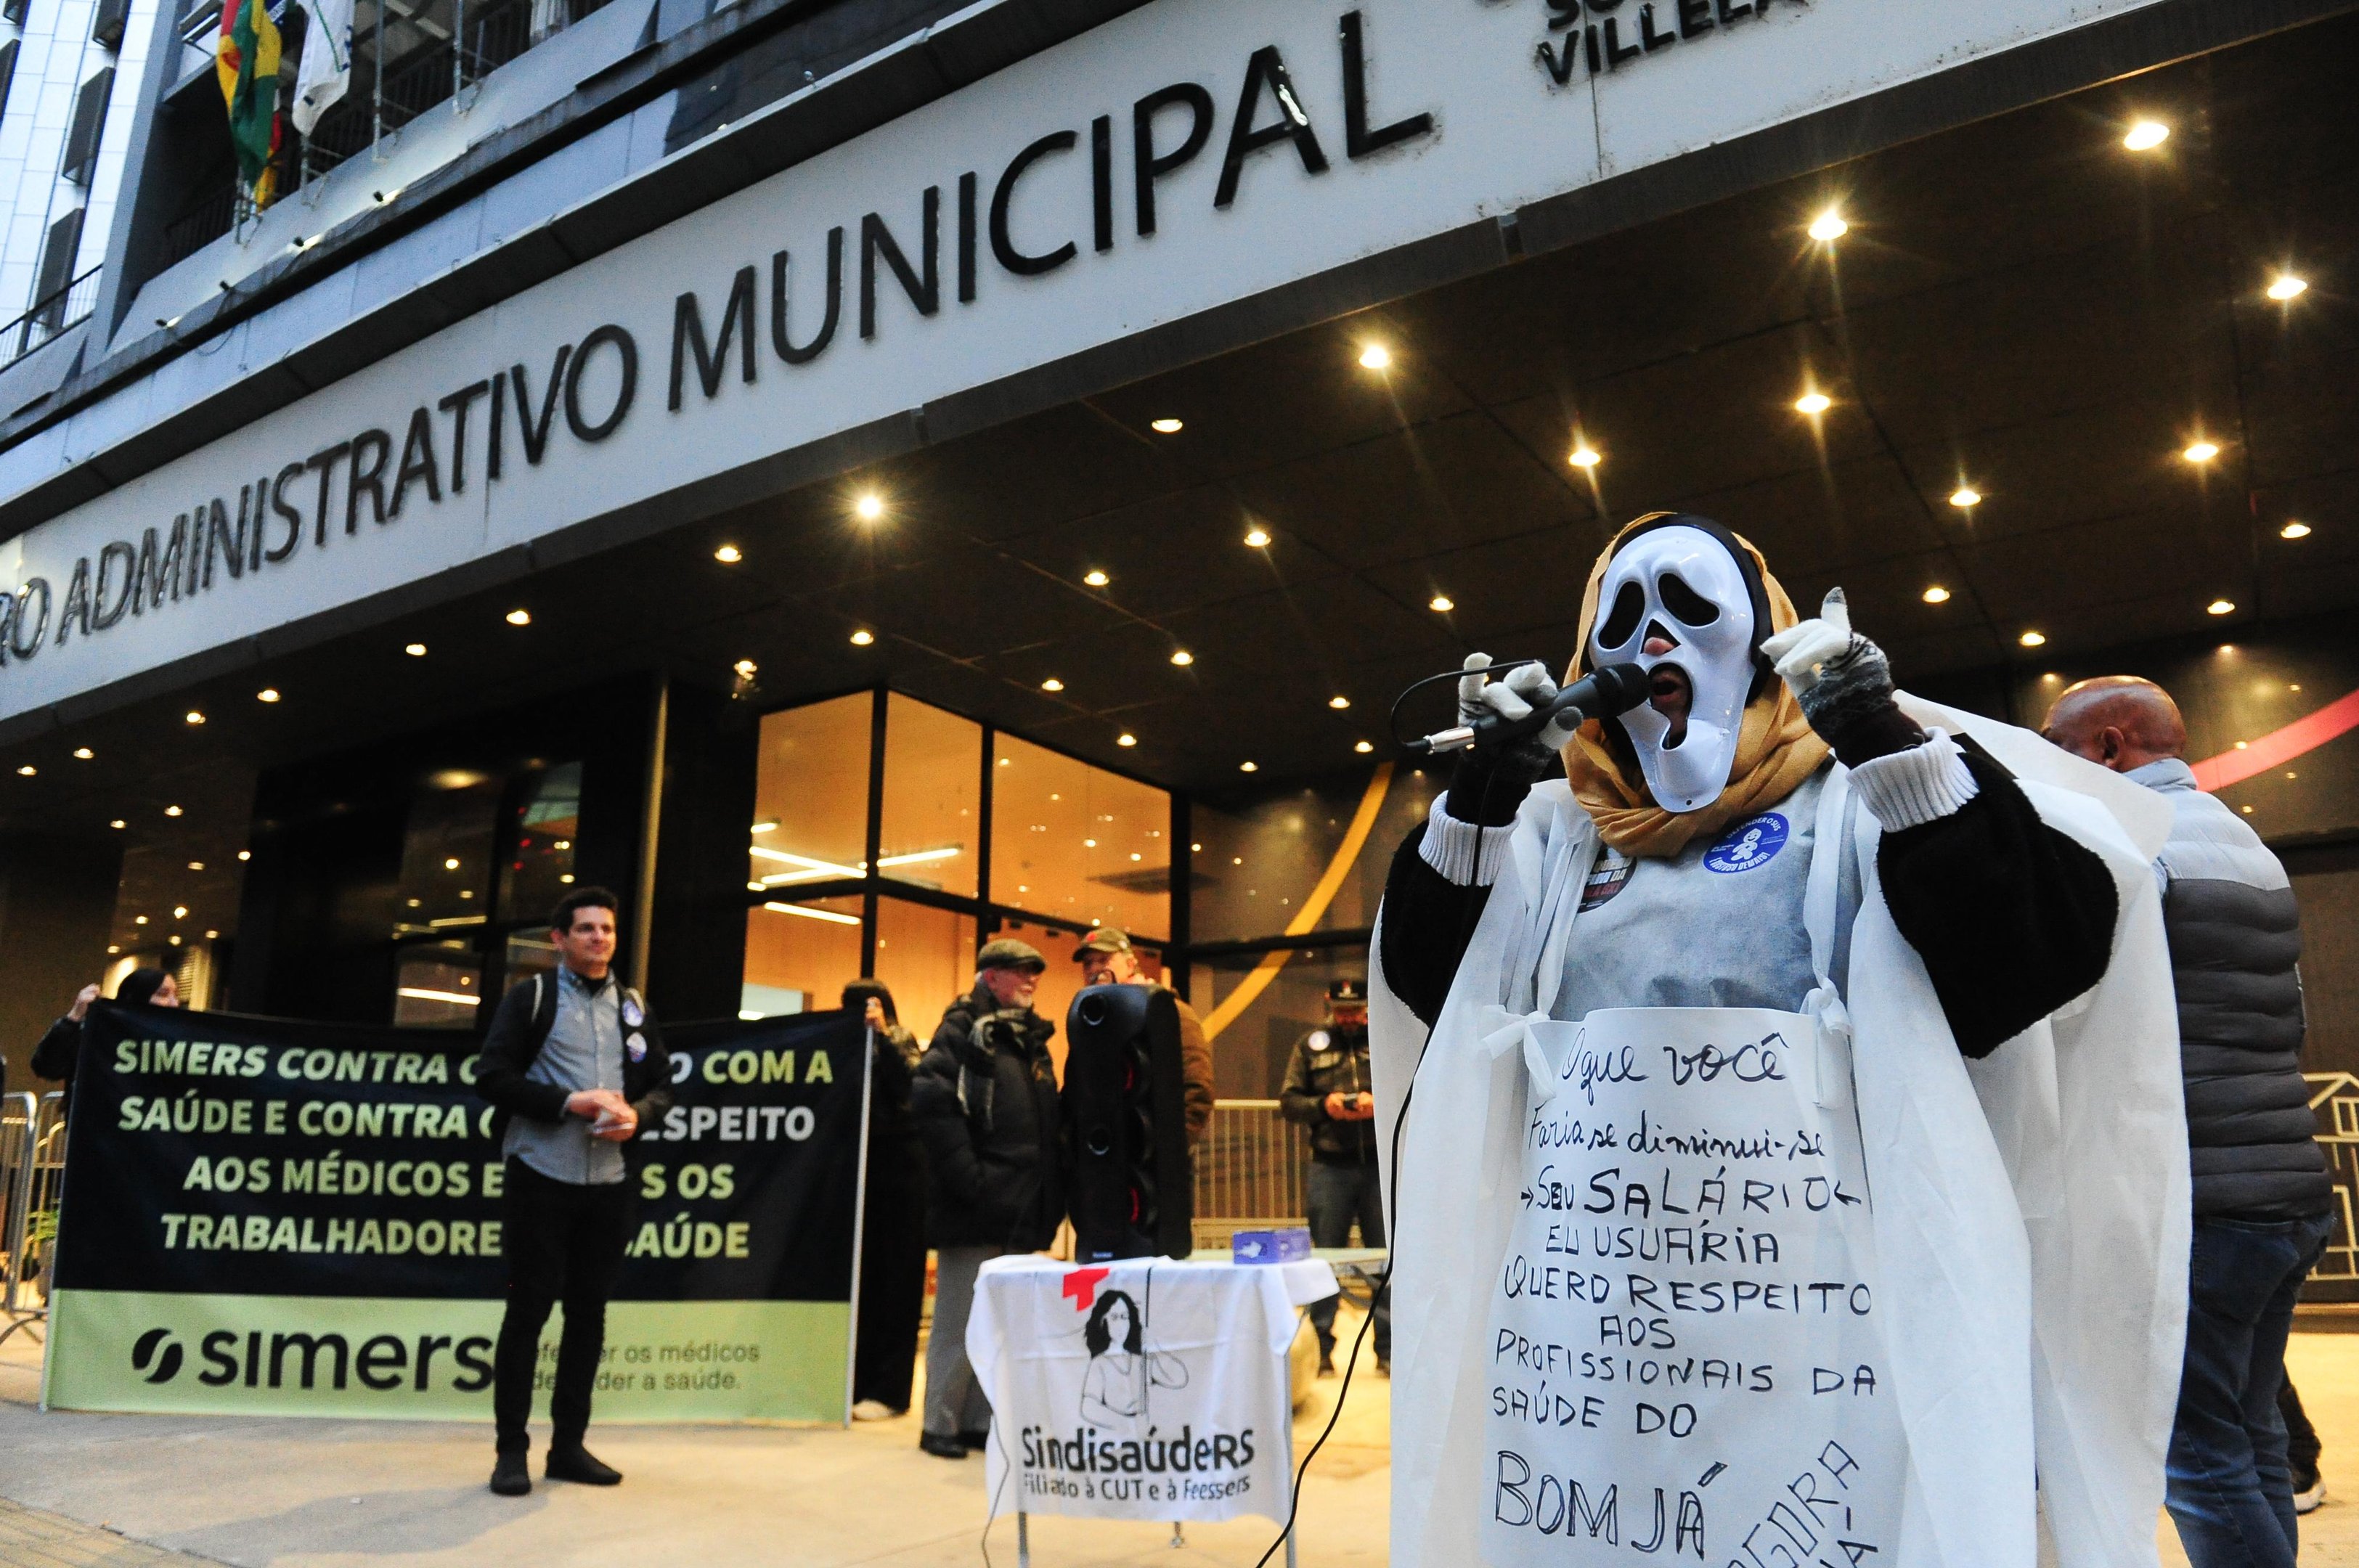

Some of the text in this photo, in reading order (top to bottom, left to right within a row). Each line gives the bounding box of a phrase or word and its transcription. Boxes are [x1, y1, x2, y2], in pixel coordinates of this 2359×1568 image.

[1538, 0, 1806, 85] VILLEL
[55, 323, 637, 645] ADMINISTRATIVO
[667, 9, 1435, 412] MUNICIPAL
[1771, 820, 1782, 832] SUS
[113, 1040, 269, 1077] SIMERS
[277, 1048, 448, 1084] CONTRA
[702, 1050, 795, 1084] COM
[804, 1050, 834, 1084] A
[118, 1089, 253, 1134] SAÚDE
[265, 1100, 288, 1135] E
[298, 1101, 468, 1138] CONTRA
[640, 1106, 815, 1142] SPEITO
[183, 1156, 271, 1193] AOS
[282, 1149, 470, 1196] MÉDICOS
[482, 1162, 506, 1197] E
[677, 1163, 734, 1199] OS
[1584, 1165, 1830, 1219] SALÁRIO
[161, 1211, 750, 1258] TRABALHADORE AÚDE
[1545, 1224, 1580, 1256] EU
[1627, 1274, 1872, 1316] RESPEITO
[624, 1345, 652, 1364] os
[659, 1340, 760, 1364] médicos
[1600, 1315, 1676, 1349] AOS
[642, 1373, 656, 1391] a
[1496, 1328, 1876, 1397] PROFISSIONAIS DA
[1492, 1379, 1698, 1439] SAÚDE DO
[1101, 1478, 1144, 1501] CUT
[1149, 1482, 1160, 1501] e
[1495, 1450, 1619, 1548] BOM
[1630, 1461, 1728, 1561] JÁ
